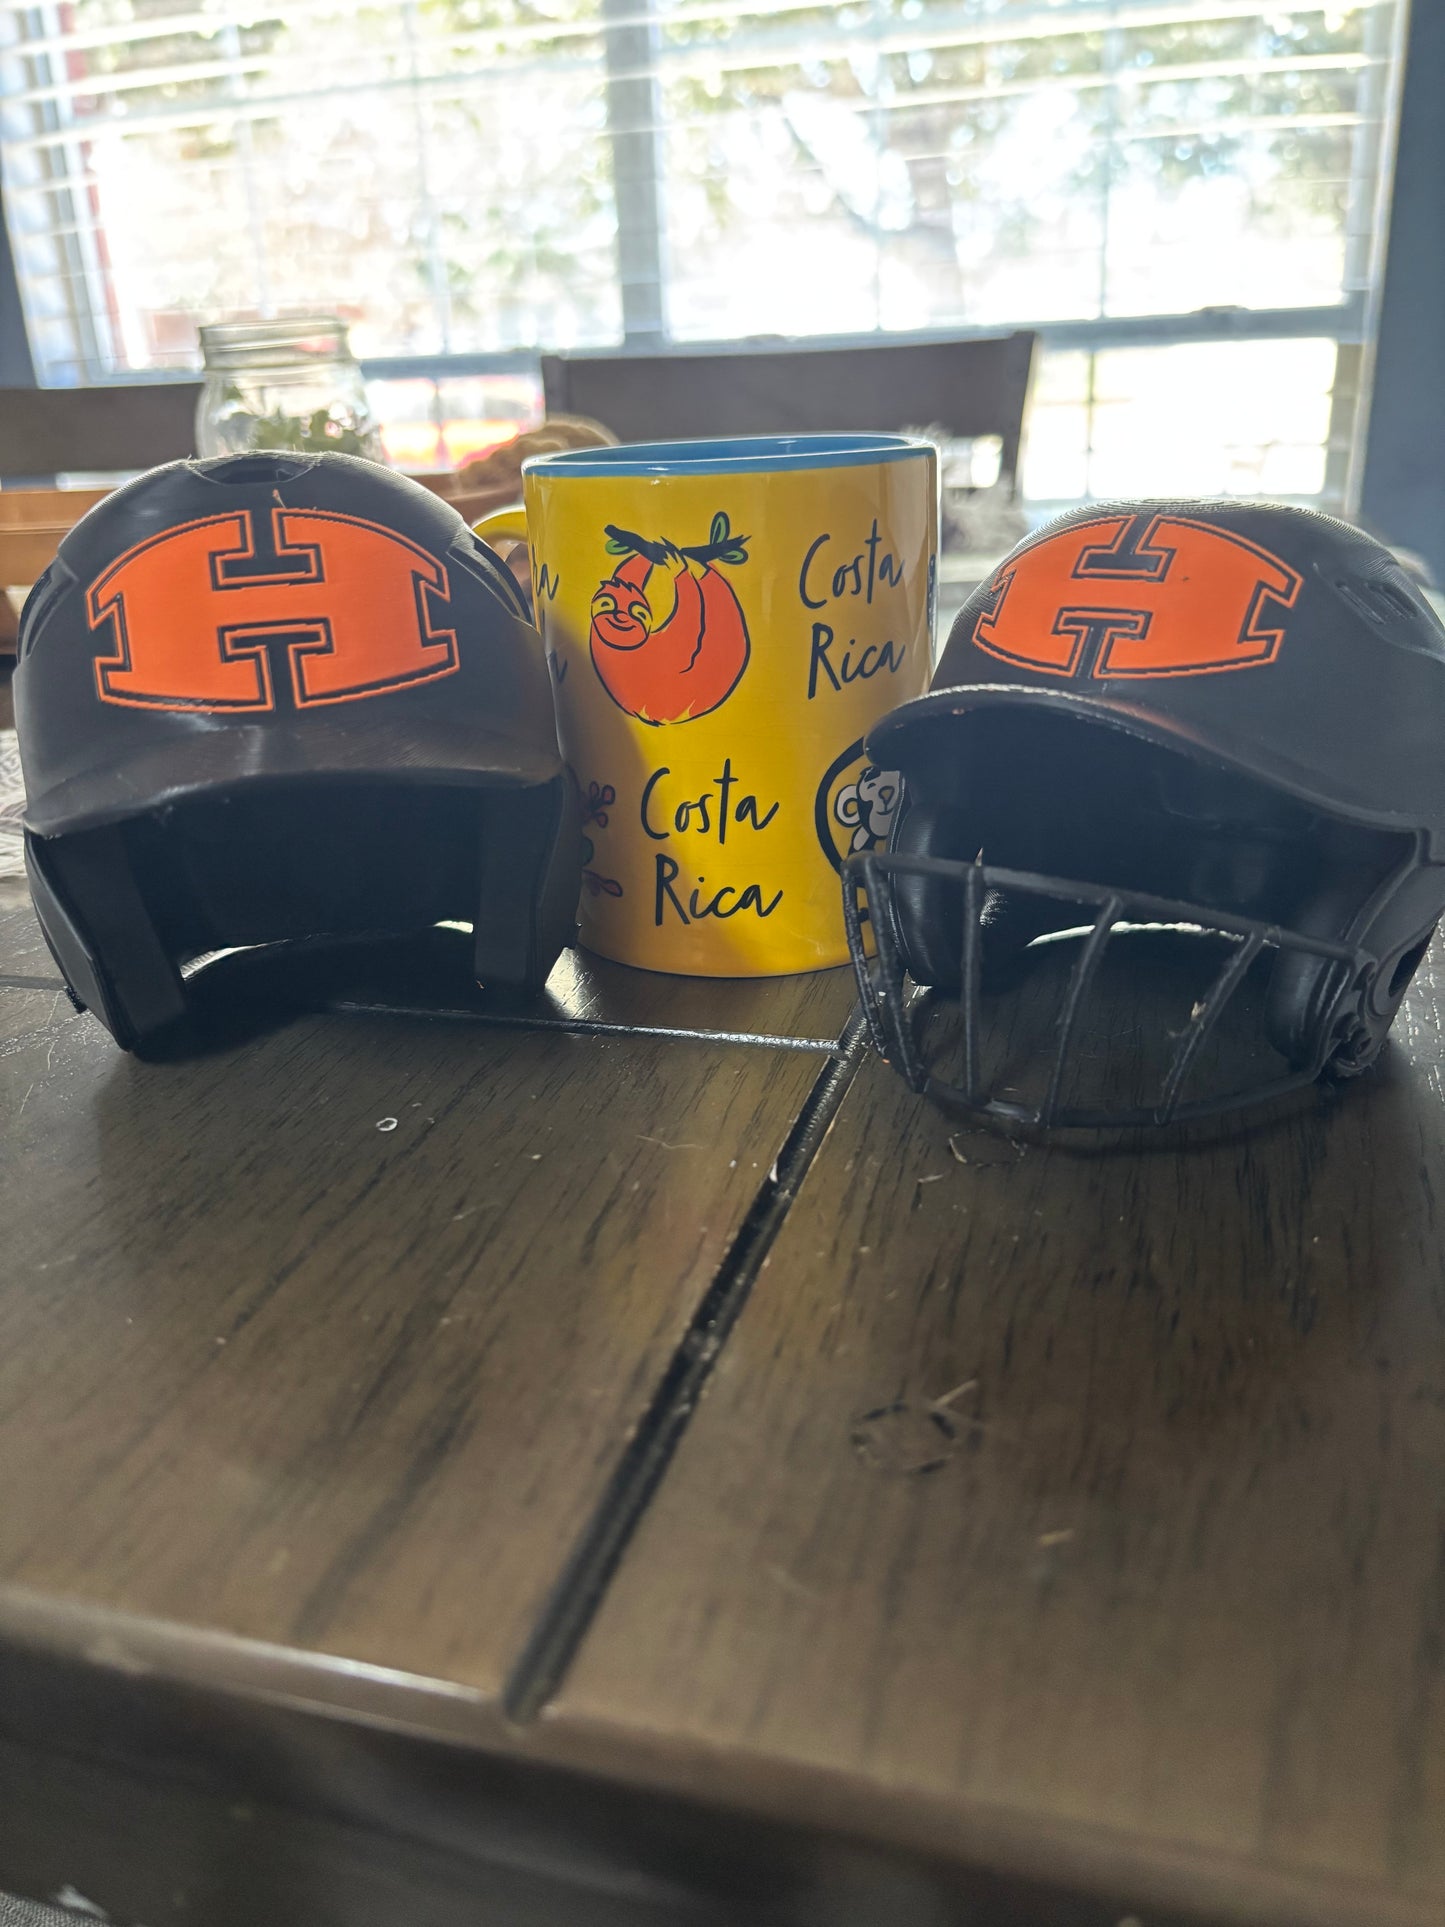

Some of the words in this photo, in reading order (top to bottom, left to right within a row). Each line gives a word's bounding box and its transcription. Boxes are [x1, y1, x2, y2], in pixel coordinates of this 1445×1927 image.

[798, 518, 905, 610] Costa
[971, 514, 1304, 680] H
[86, 508, 461, 713] H
[807, 622, 906, 700] Rica
[640, 757, 780, 845] Costa
[655, 853, 783, 927] Rica
